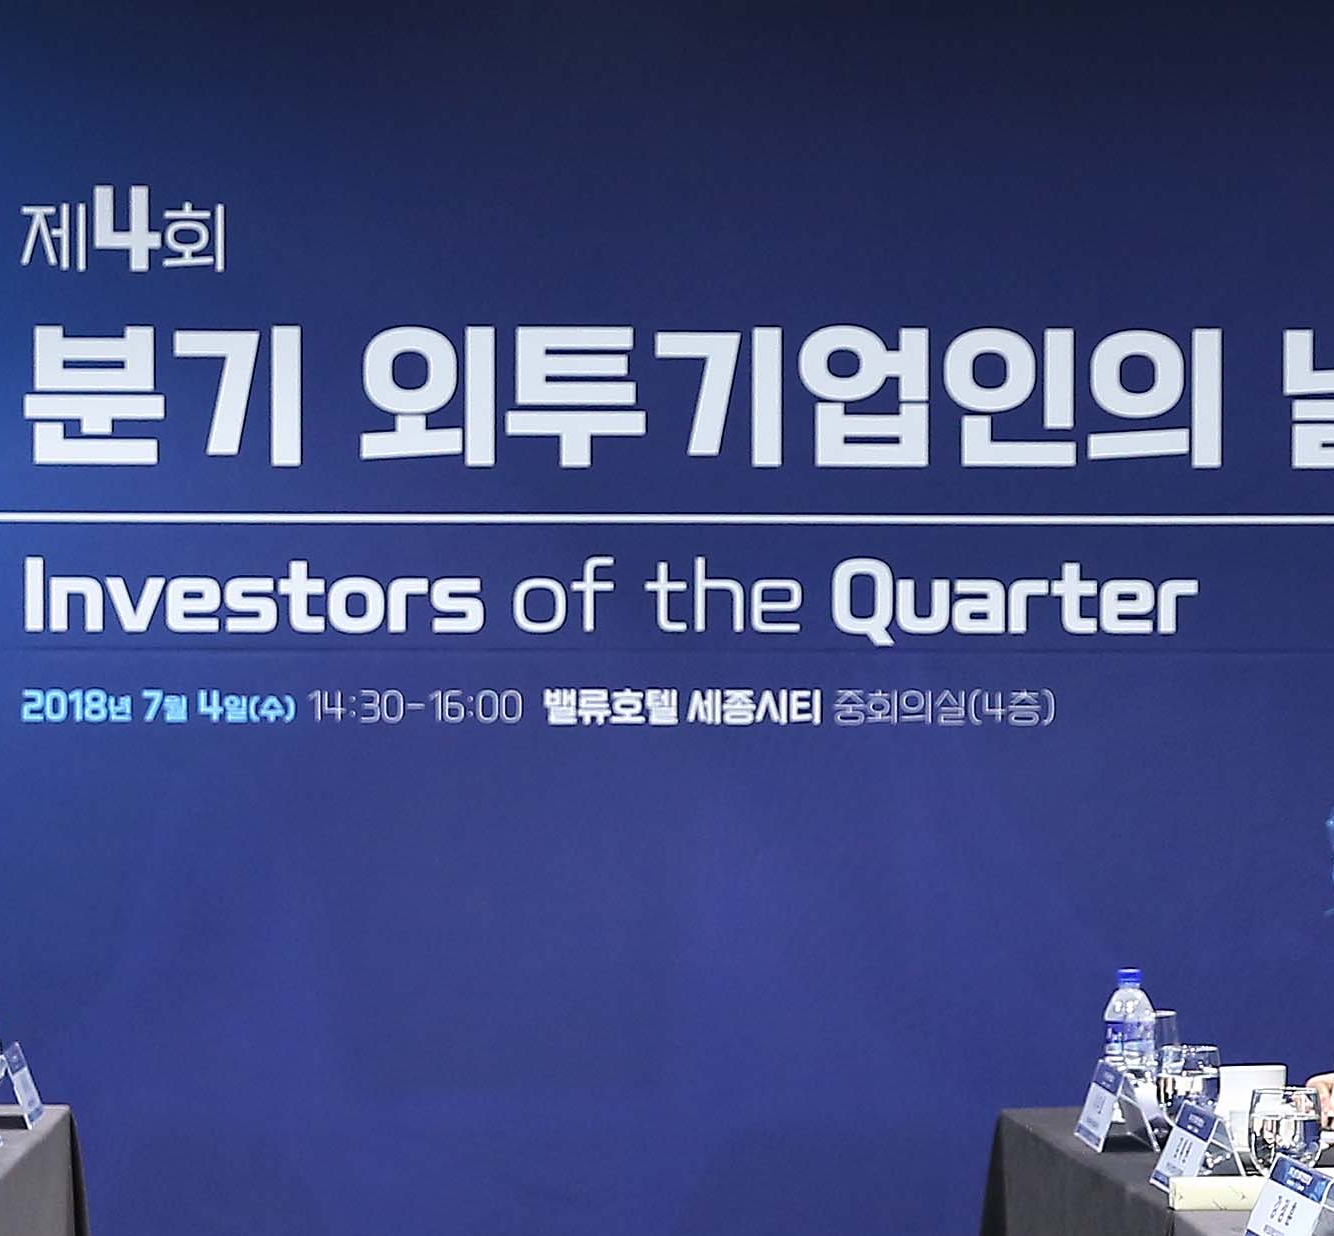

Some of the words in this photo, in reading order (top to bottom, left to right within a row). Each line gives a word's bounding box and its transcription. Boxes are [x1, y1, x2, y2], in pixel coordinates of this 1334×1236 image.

[20, 185, 225, 273] 제4회
[23, 325, 302, 467] 분기
[359, 325, 1222, 467] 외투기업인의
[24, 556, 484, 634] Investors
[512, 556, 615, 634] of
[644, 556, 803, 633] the
[831, 557, 1199, 646] Quarter
[22, 688, 132, 723] 2018년
[142, 688, 188, 723] 7월
[198, 688, 297, 724] 4일(수)
[308, 688, 524, 724] 14:30-16:00
[543, 688, 678, 726] 밸류호텔
[686, 688, 822, 726] 세종시티
[834, 688, 1056, 726] 중회의실(4층)
